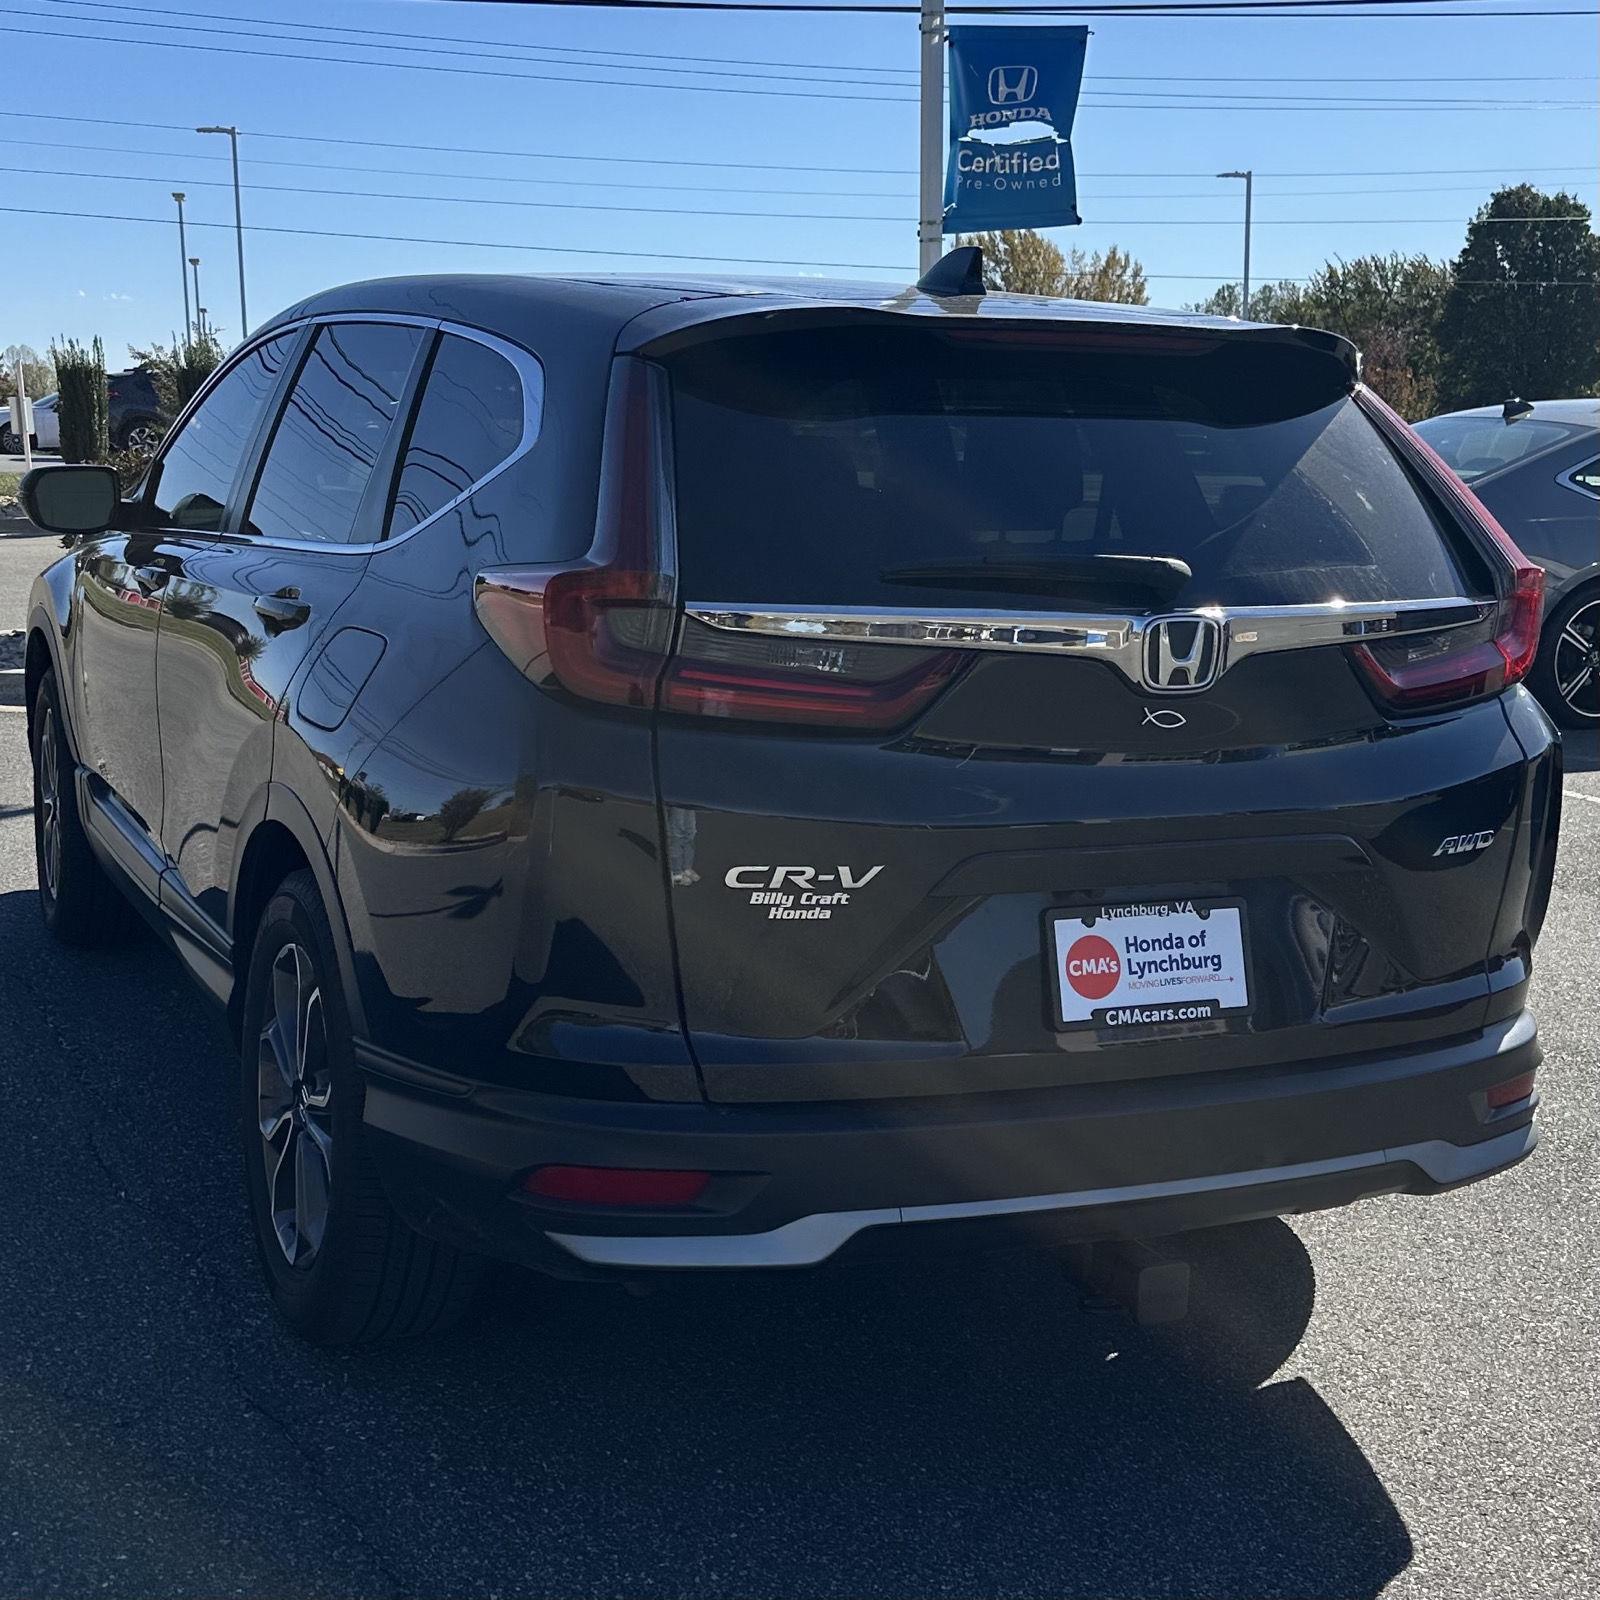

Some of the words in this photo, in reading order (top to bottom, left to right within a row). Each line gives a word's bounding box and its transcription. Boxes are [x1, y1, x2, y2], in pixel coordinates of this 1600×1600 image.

[970, 107, 1053, 127] HONDA
[958, 146, 1060, 173] Certified
[956, 173, 1061, 190] Pre-Owned
[1432, 830, 1494, 857] AWD
[724, 865, 886, 889] CR-V
[749, 892, 794, 907] Billy
[800, 893, 850, 905] Craft
[1176, 901, 1196, 914] VA
[768, 907, 831, 920] Honda
[1125, 933, 1185, 953] Honda
[1188, 930, 1207, 947] of
[1069, 957, 1118, 976] CMA's
[1127, 954, 1222, 979] Lynchburg
[1105, 1005, 1212, 1026] CMAcars.com
